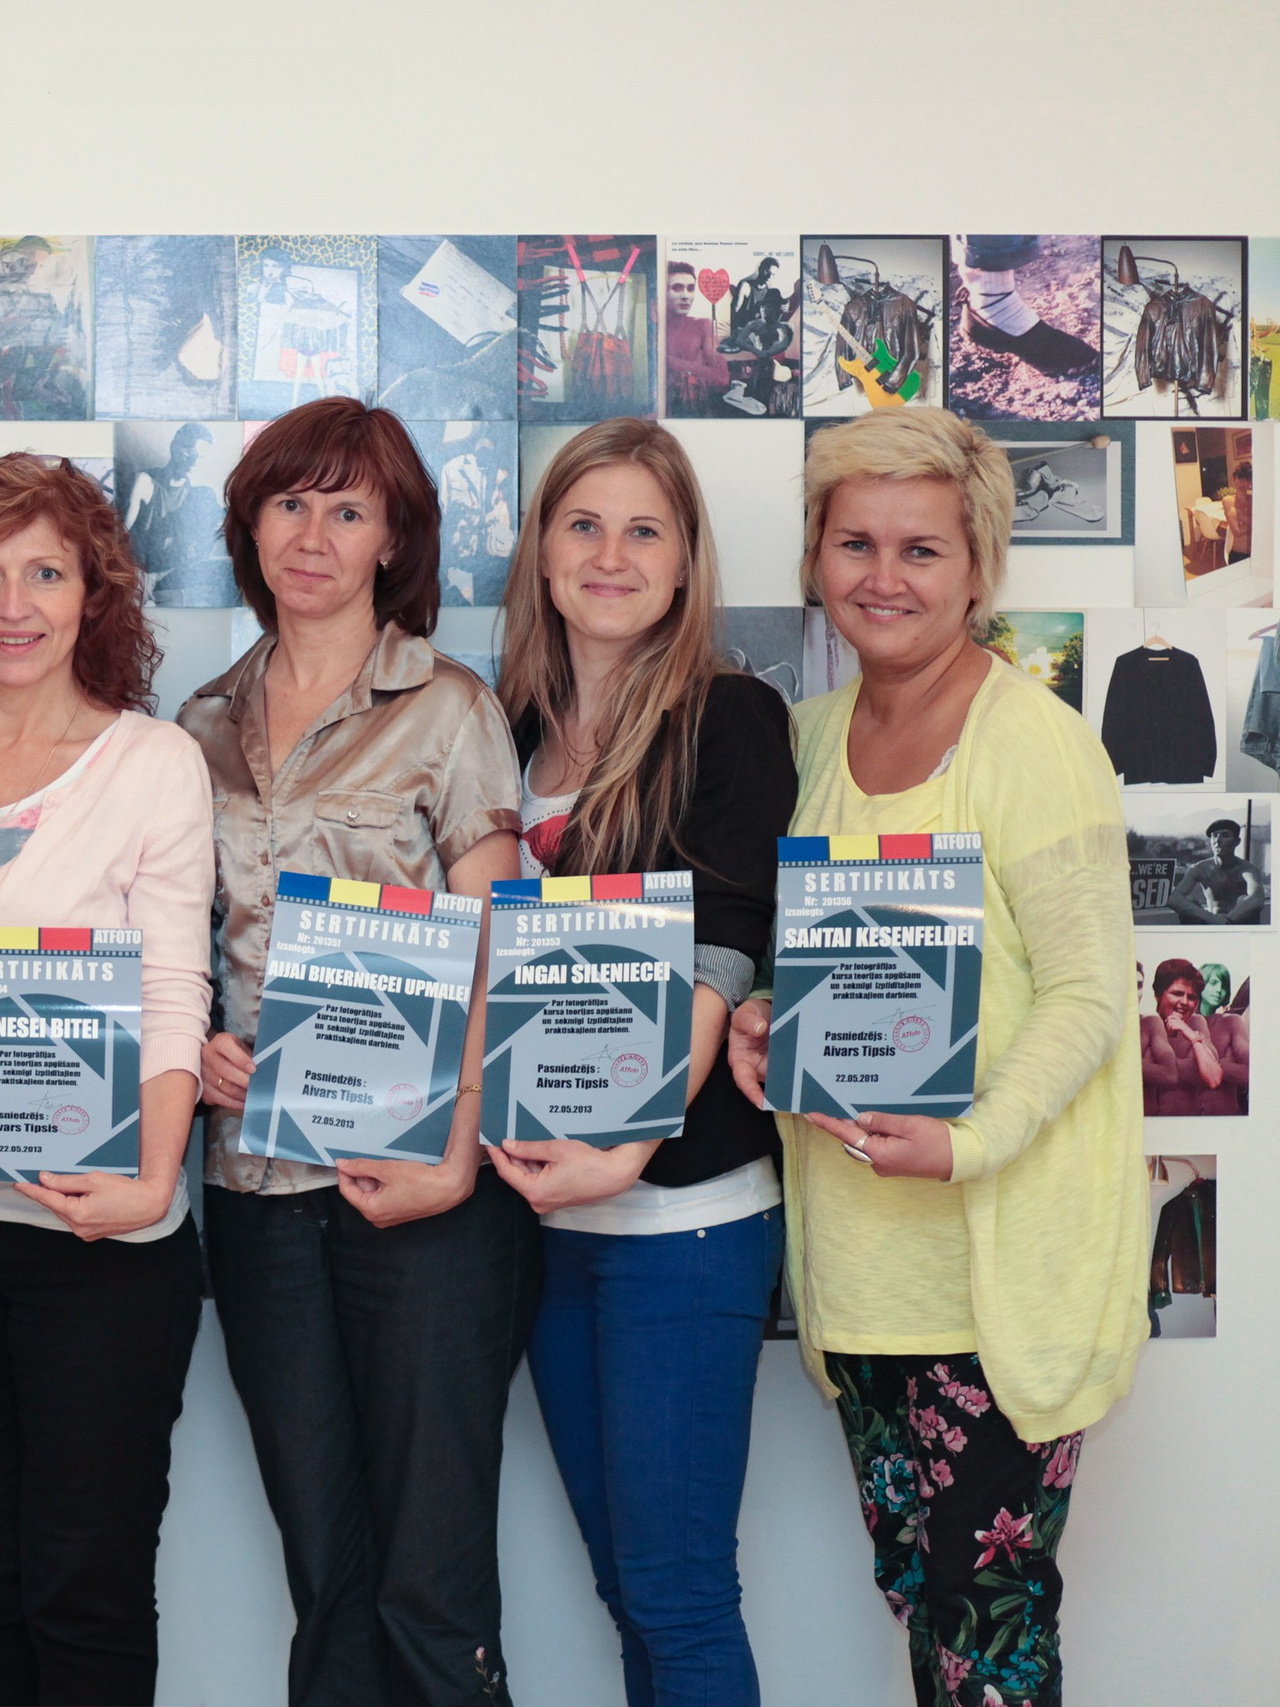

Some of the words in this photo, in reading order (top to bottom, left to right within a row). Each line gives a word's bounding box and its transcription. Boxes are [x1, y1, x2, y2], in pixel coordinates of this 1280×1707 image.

[934, 834, 981, 850] ATFOTO
[645, 873, 692, 889] ATFOTO
[805, 868, 955, 892] SERTIFIKĀTS
[434, 893, 482, 914] ATFOTO
[804, 896, 817, 906] Nr:
[822, 897, 851, 905] 201356
[299, 910, 450, 949] SERTIFIKĀTS
[94, 930, 141, 943] ATFOTO
[297, 932, 311, 943] Nr:
[312, 935, 341, 947] 201351
[515, 936, 529, 947] Nr:
[531, 937, 560, 947] 201353
[784, 927, 851, 948] SANTAI
[855, 925, 974, 947] KESENFELDEI
[514, 963, 566, 985] INGAI
[571, 959, 671, 985] SILENIECEI
[854, 972, 882, 980] teorijas
[267, 959, 306, 980] AIJAI
[308, 965, 402, 994] BIĶERNIECEI
[403, 977, 470, 1002] UPMALEI
[832, 991, 883, 1000] praktiskajiem
[325, 1004, 338, 1012] Par
[565, 1007, 594, 1016] teorijas
[316, 1013, 338, 1021] kursa
[338, 1015, 368, 1026] teorijas
[50, 1018, 98, 1039] BITEI
[545, 1025, 596, 1035] praktiskajiem
[597, 1025, 630, 1033] darbiem.
[315, 1032, 367, 1045] praktiskajiem
[367, 1039, 401, 1050] darbiem.
[823, 1045, 859, 1056] Aivars
[862, 1045, 895, 1058] Tipsis
[14, 1060, 41, 1068] teorijas
[45, 1078, 78, 1086] darbiem.
[536, 1076, 572, 1088] Aivars
[574, 1076, 609, 1089] Tipsis
[835, 1073, 878, 1083] 22.05.2013
[301, 1084, 338, 1098] Aivars
[339, 1089, 374, 1105] Tipsis
[549, 1103, 592, 1114] 22.05.2013
[311, 1115, 355, 1128] 22.05.2013
[24, 1123, 57, 1134] Tipsis
[0, 1145, 42, 1153] 22.05.2013
